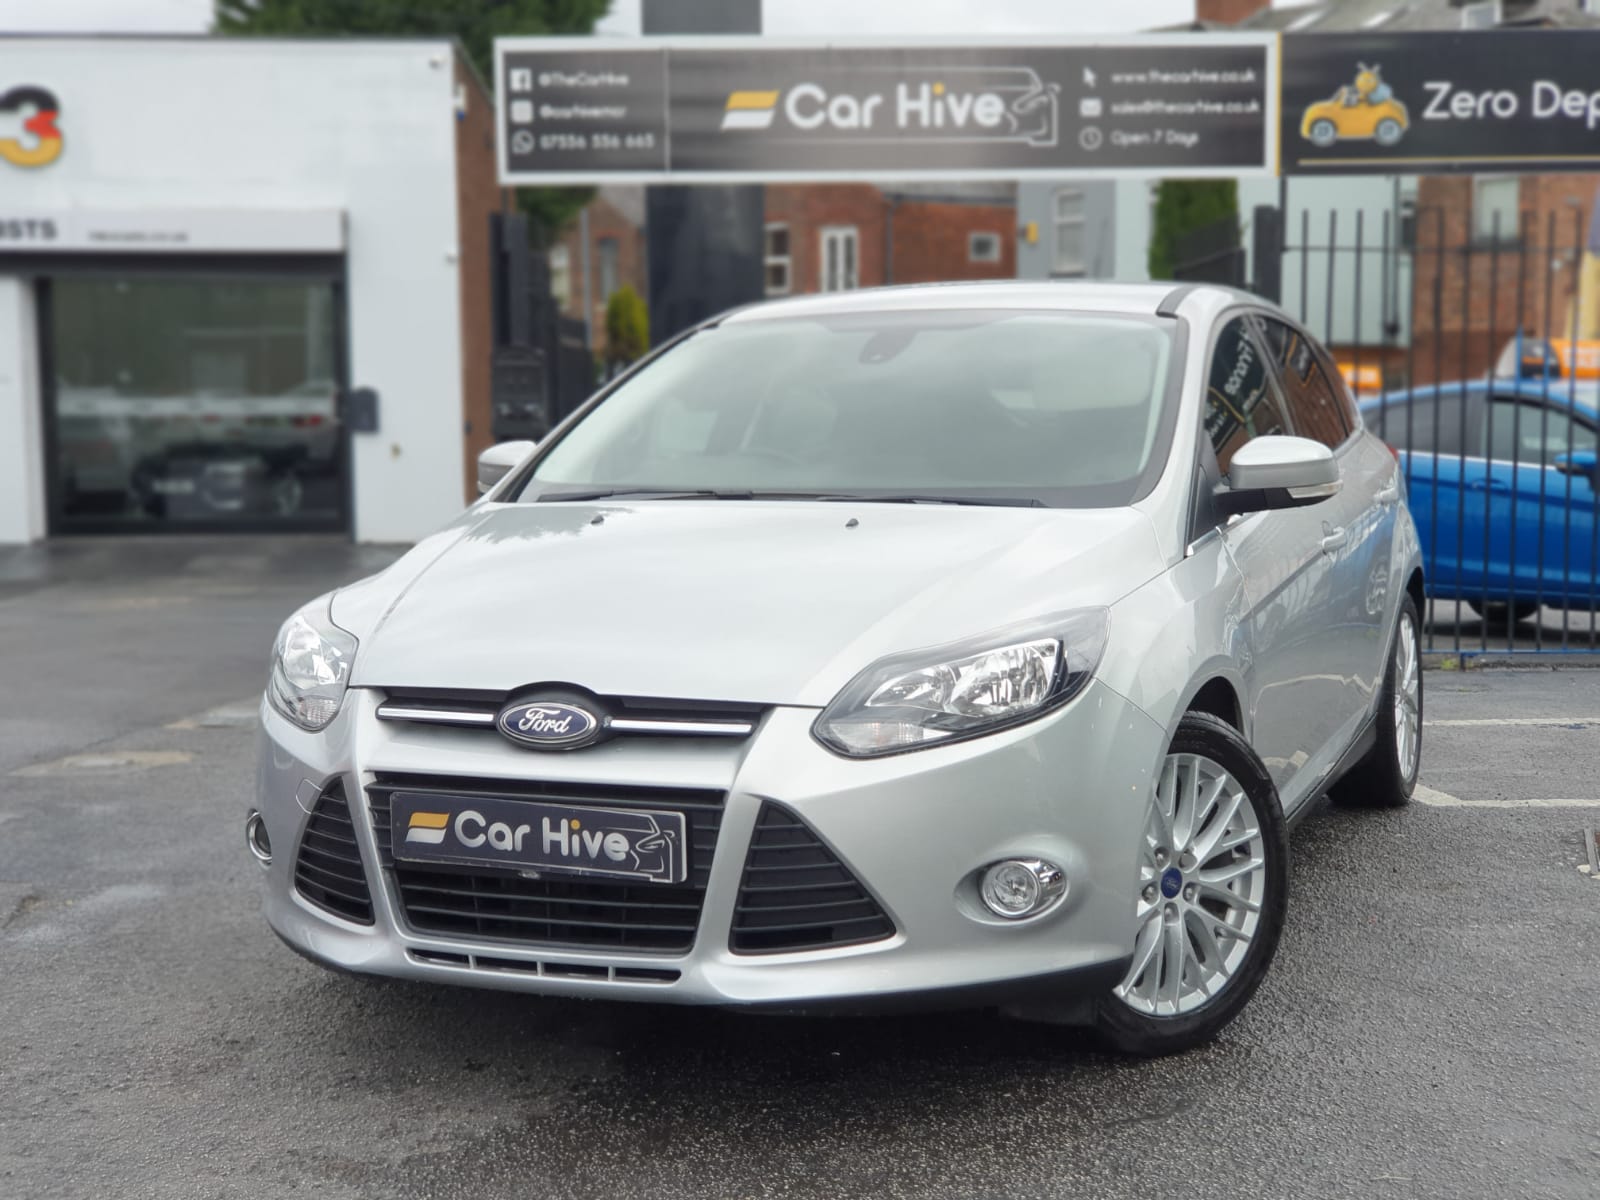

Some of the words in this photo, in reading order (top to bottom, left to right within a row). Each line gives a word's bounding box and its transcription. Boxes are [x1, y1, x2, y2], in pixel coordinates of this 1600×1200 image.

[1111, 68, 1255, 84] www.thecarhive.co.uk
[784, 83, 883, 129] Car
[896, 82, 1005, 129] Hive
[1111, 99, 1259, 115] sales@thecarhive.co.uk
[1422, 81, 1519, 120] Zero
[1110, 130, 1150, 148] Open
[1153, 130, 1164, 143] 7
[1165, 130, 1199, 148] Days
[518, 707, 573, 733] Ford
[454, 809, 531, 852] Car
[542, 816, 630, 861] Hive
